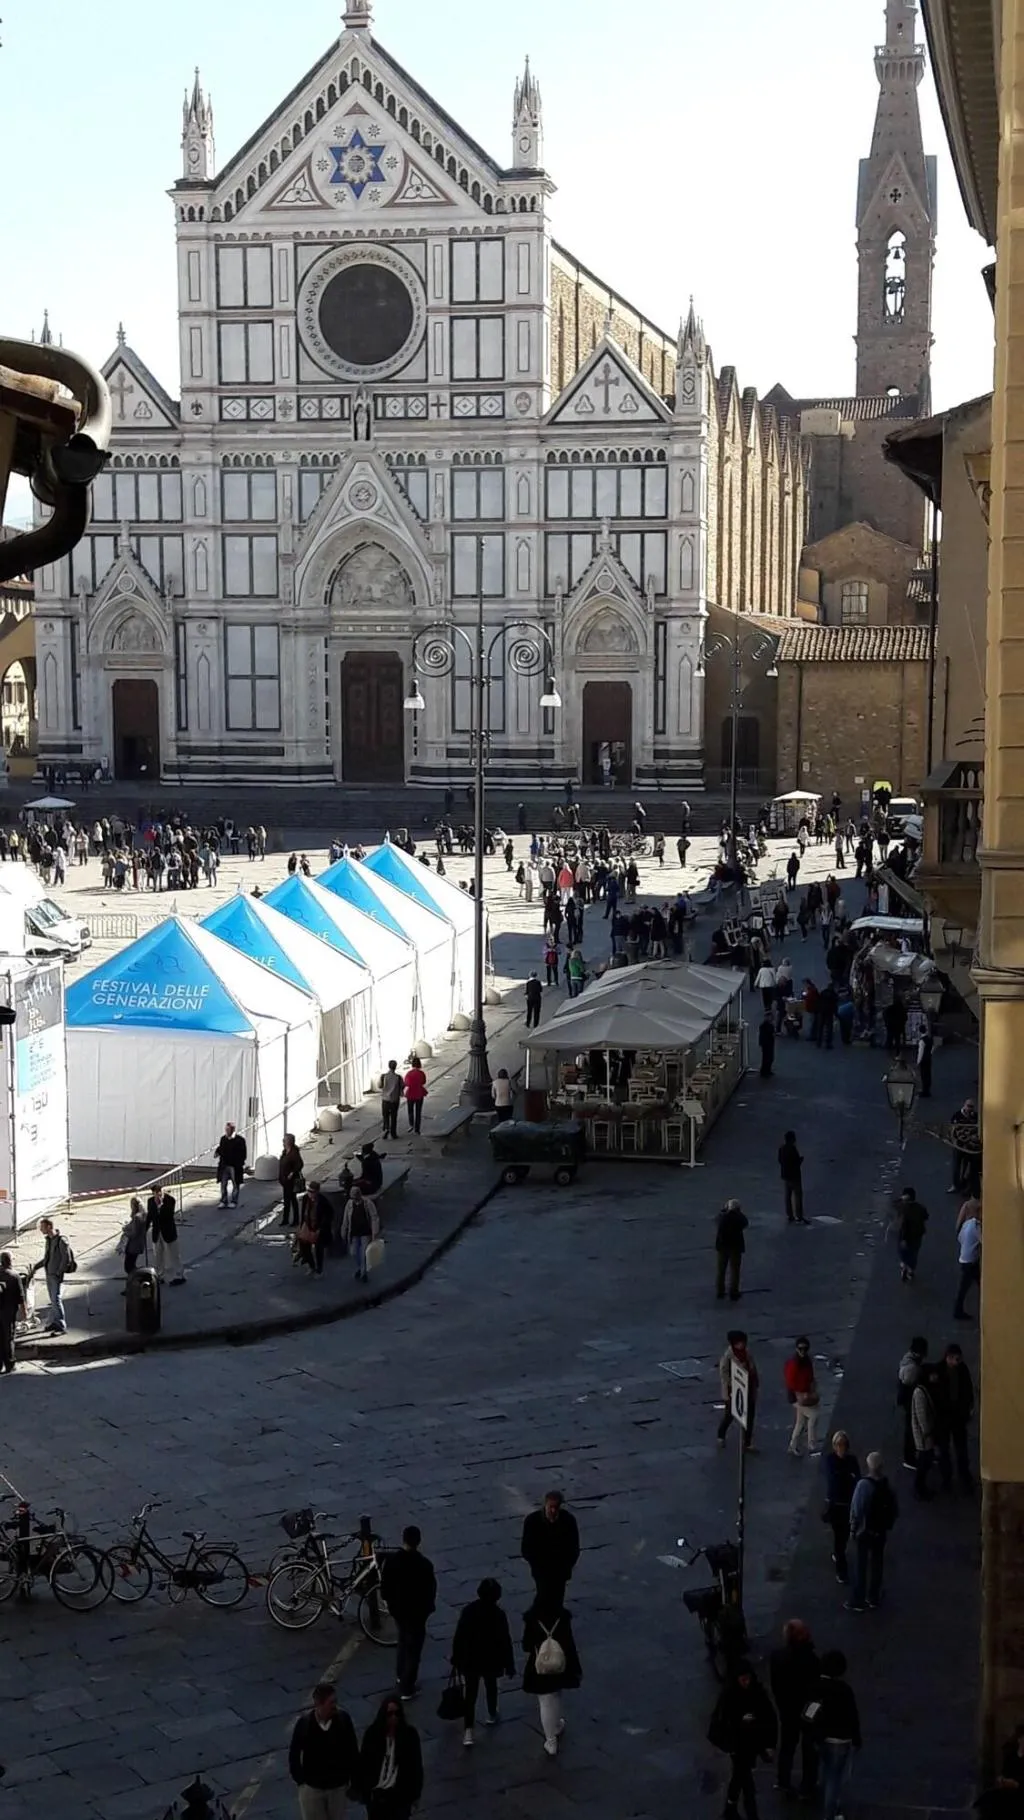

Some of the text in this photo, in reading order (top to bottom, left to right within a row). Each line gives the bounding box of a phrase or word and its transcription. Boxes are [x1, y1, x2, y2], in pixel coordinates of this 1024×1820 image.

[92, 979, 210, 997] FESTIVAL DELLE
[92, 992, 203, 1010] GENERAZIONI
